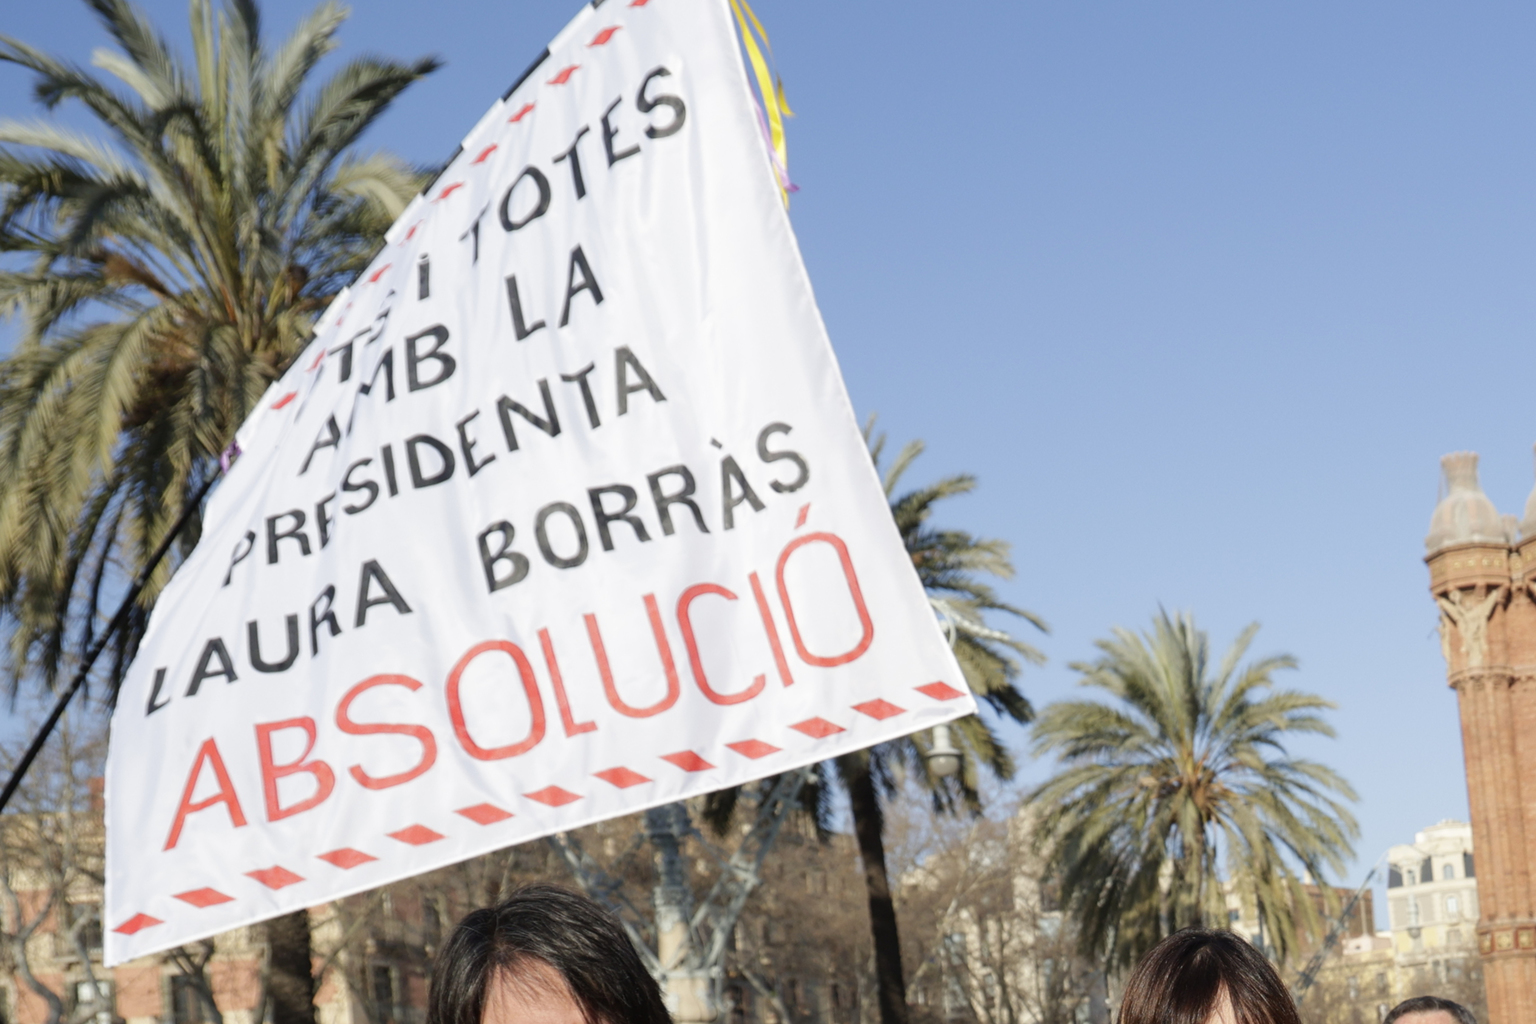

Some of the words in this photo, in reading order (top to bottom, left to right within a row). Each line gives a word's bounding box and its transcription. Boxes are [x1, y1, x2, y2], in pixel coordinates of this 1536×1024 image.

[458, 65, 688, 266] TOTES
[504, 244, 605, 343] LA
[145, 557, 414, 718] LAURA
[476, 421, 812, 596] BORRÀS
[221, 347, 668, 589] PRESIDENTA
[163, 503, 876, 852] ABSOLUCIÓ
